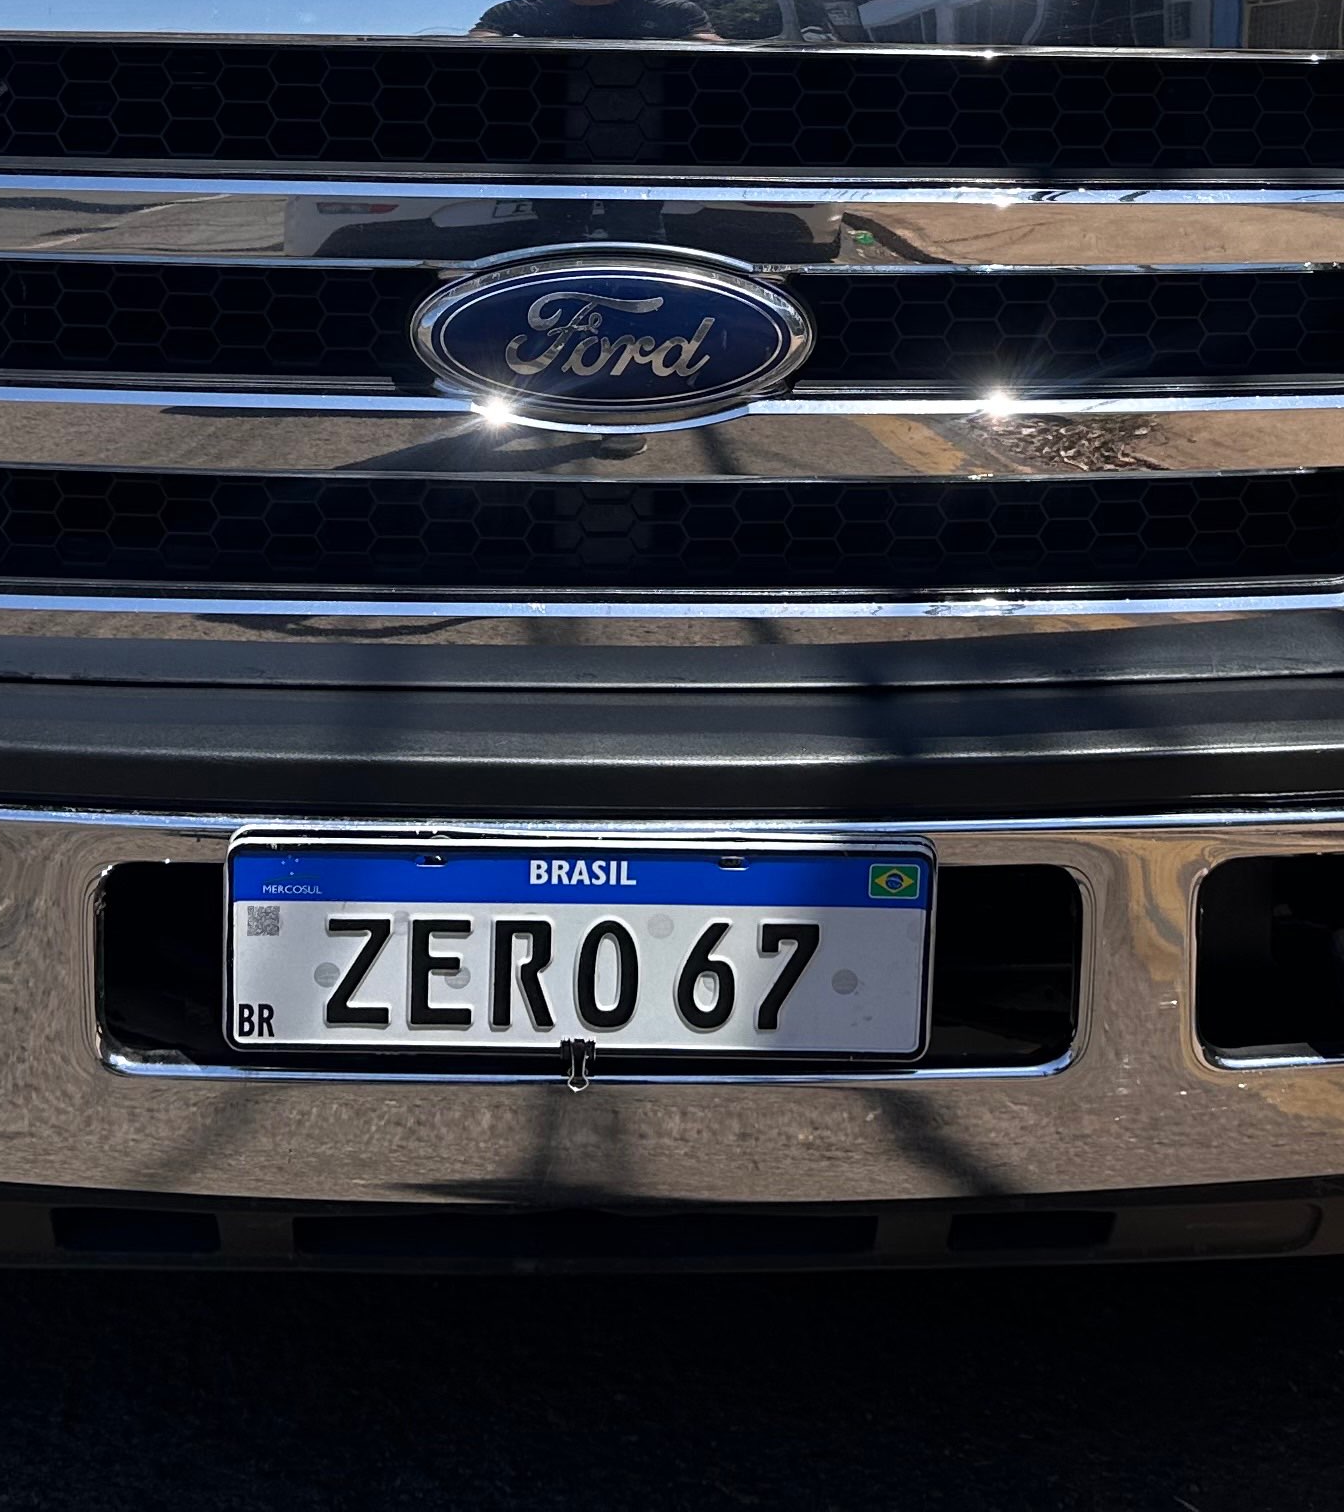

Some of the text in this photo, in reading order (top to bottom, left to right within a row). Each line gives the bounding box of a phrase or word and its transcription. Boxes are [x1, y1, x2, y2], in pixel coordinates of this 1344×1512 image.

[505, 291, 716, 377] Ford
[262, 884, 323, 895] MERCOSUL
[529, 859, 637, 886] BRASIL
[677, 921, 820, 1031] 67
[238, 1003, 275, 1038] BR
